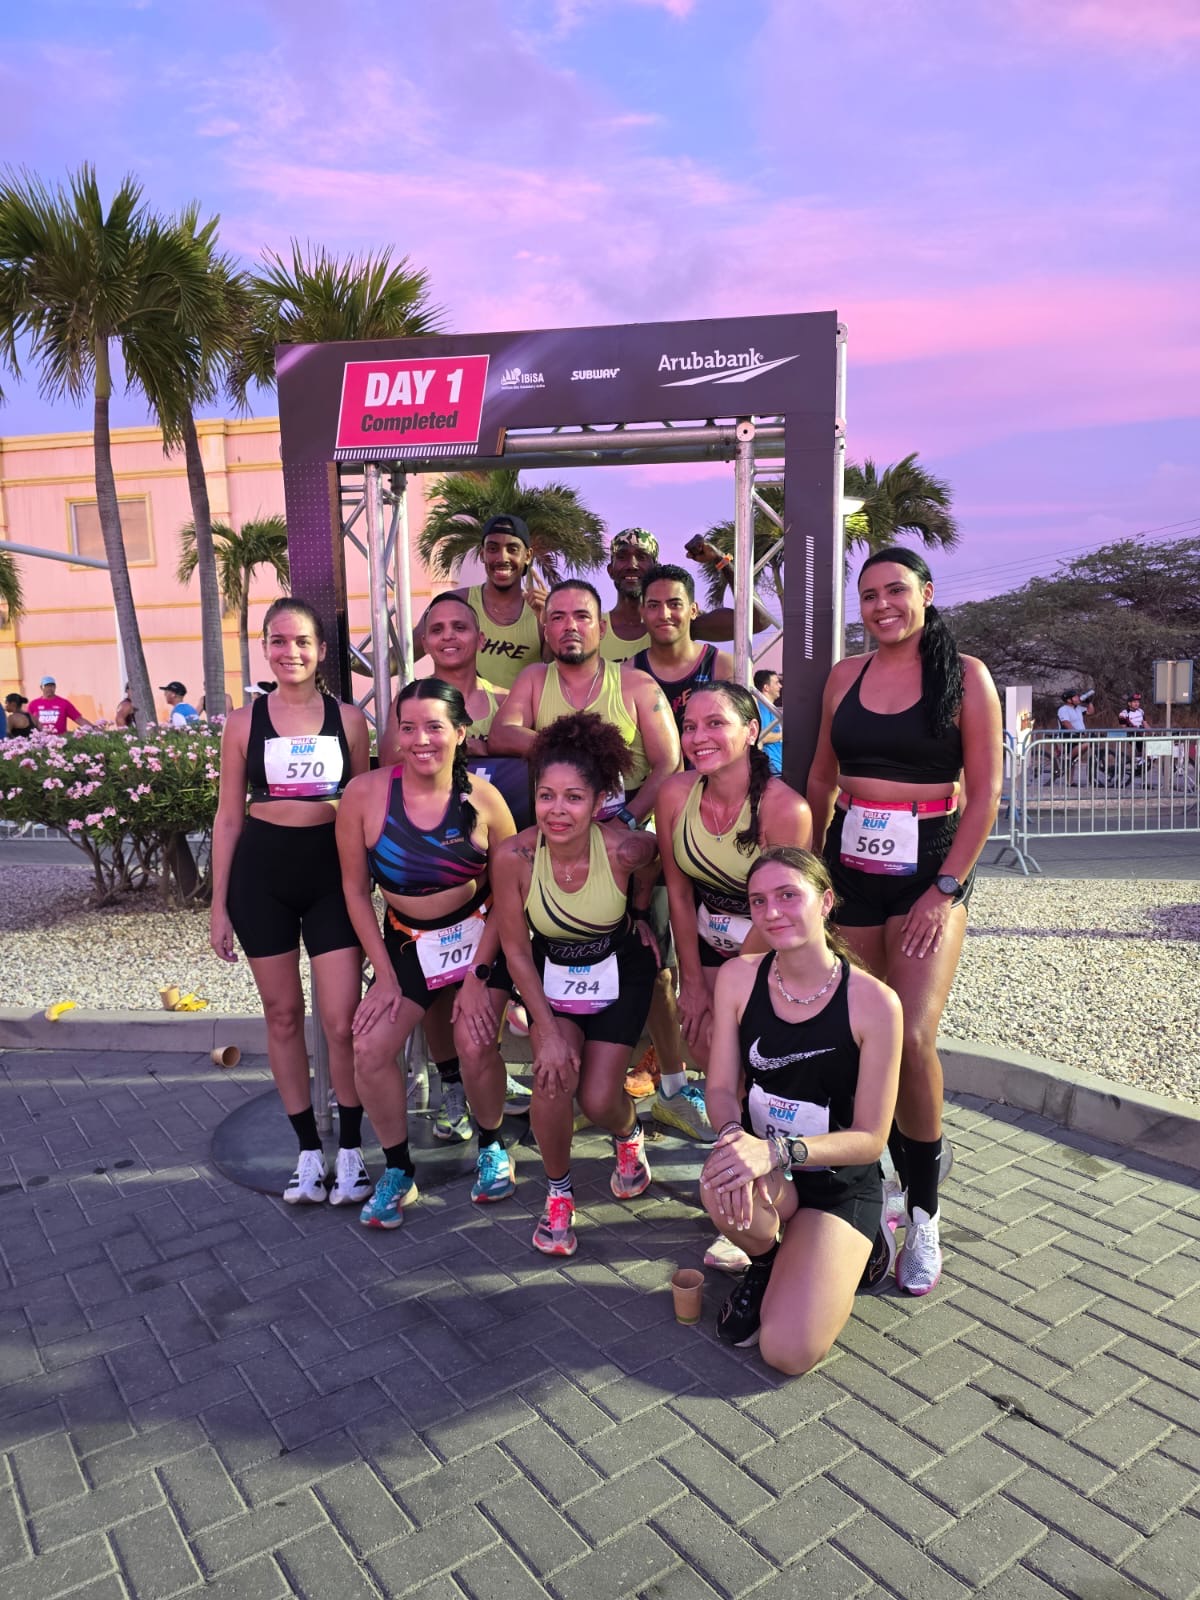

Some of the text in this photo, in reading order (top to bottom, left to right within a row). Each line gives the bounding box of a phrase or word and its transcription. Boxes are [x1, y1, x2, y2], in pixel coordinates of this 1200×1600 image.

[658, 348, 760, 372] Arubabank
[571, 368, 620, 381] SUBWAY
[364, 368, 464, 408] DAY 1
[361, 410, 459, 434] Completed
[481, 638, 530, 659] HRE
[291, 745, 315, 754] RUN
[286, 761, 325, 779] 570
[862, 818, 887, 829] RUN
[856, 836, 895, 856] 569
[709, 920, 729, 933] RUN
[440, 932, 462, 945] RUN
[439, 943, 473, 969] 707
[568, 966, 592, 974] RUN
[563, 980, 600, 995] 784
[769, 1107, 796, 1121] RUN
[766, 1124, 804, 1138] 87
